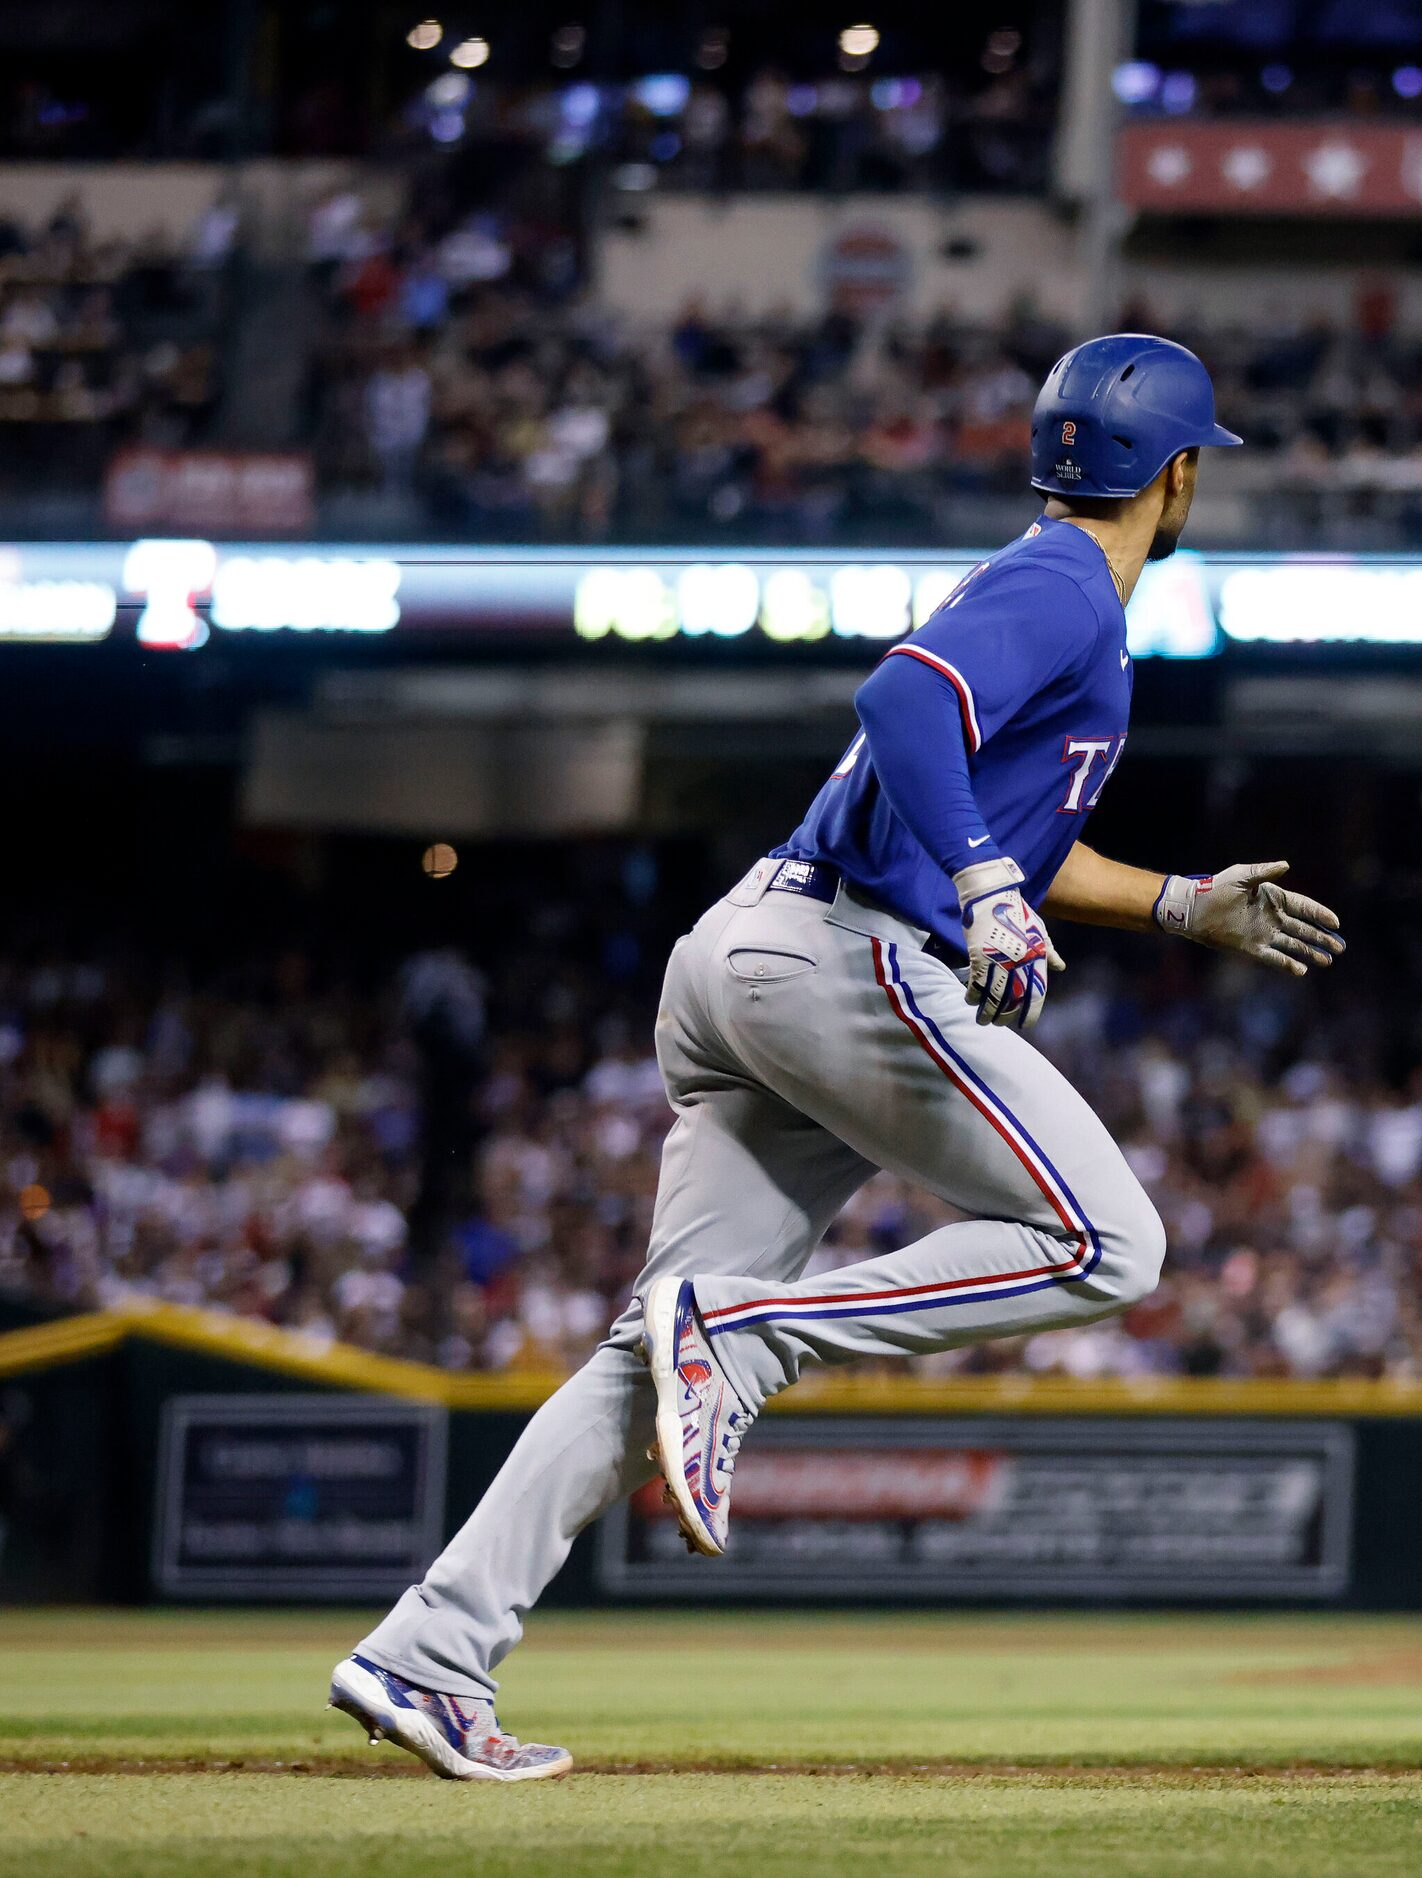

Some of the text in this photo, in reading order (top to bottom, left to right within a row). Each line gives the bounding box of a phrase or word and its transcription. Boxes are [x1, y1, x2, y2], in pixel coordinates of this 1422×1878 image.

[1062, 421, 1076, 445] 2
[1055, 463, 1082, 474] WORLD
[1055, 471, 1082, 481] SERIES
[1167, 909, 1185, 922] 2
